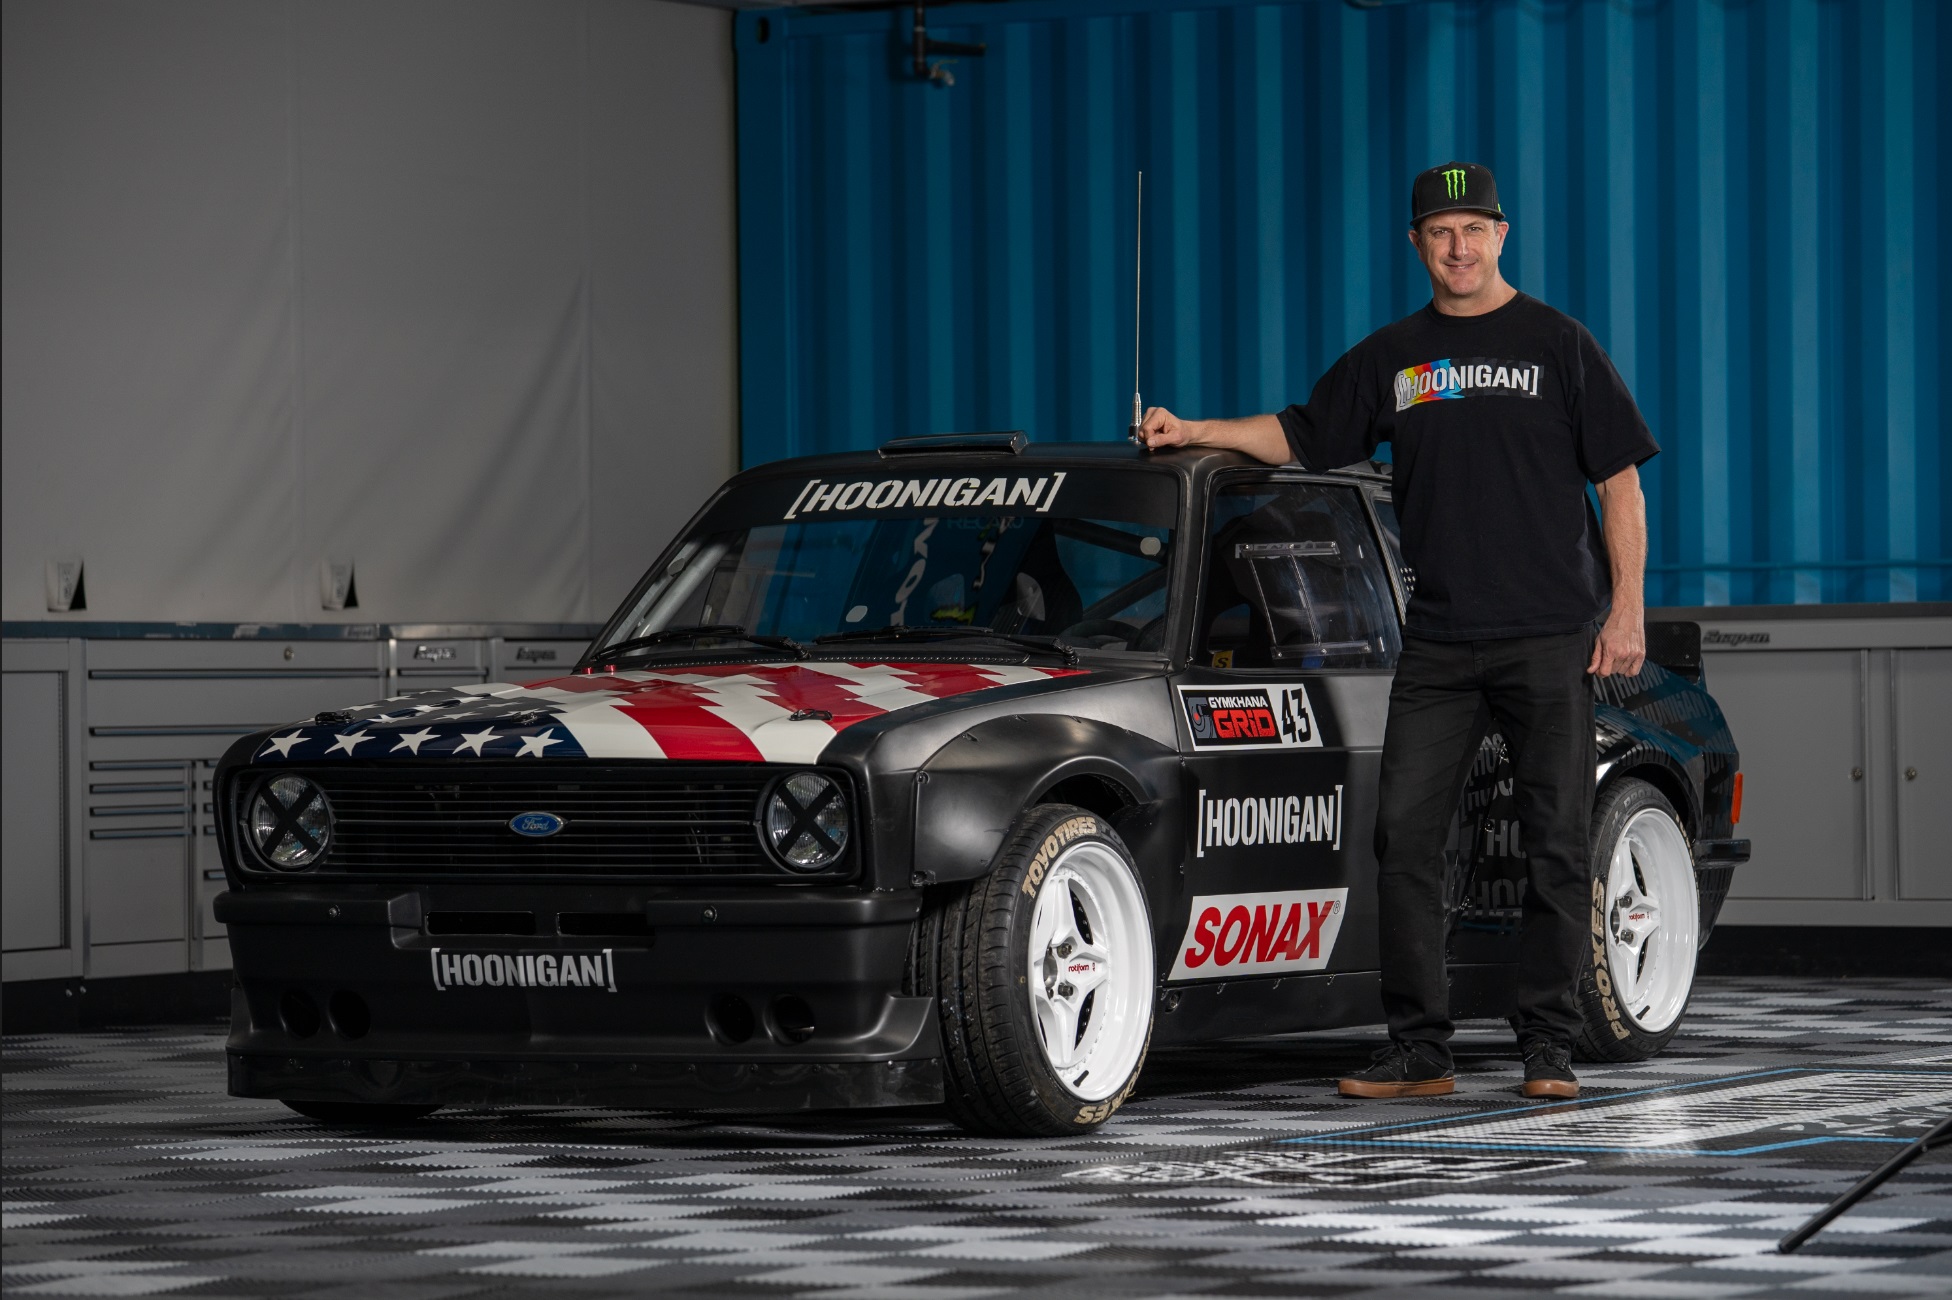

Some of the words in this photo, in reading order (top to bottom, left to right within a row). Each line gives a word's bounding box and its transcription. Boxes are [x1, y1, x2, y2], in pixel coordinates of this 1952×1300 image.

[783, 472, 1067, 520] [HOONIGAN]
[1208, 695, 1268, 709] GYMKHANA
[1282, 688, 1311, 743] 43
[522, 817, 549, 831] Ford
[1196, 785, 1344, 858] [HOONIGAN]
[431, 948, 618, 993] [HOONIGAN]
[1591, 876, 1632, 1041] PROXES
